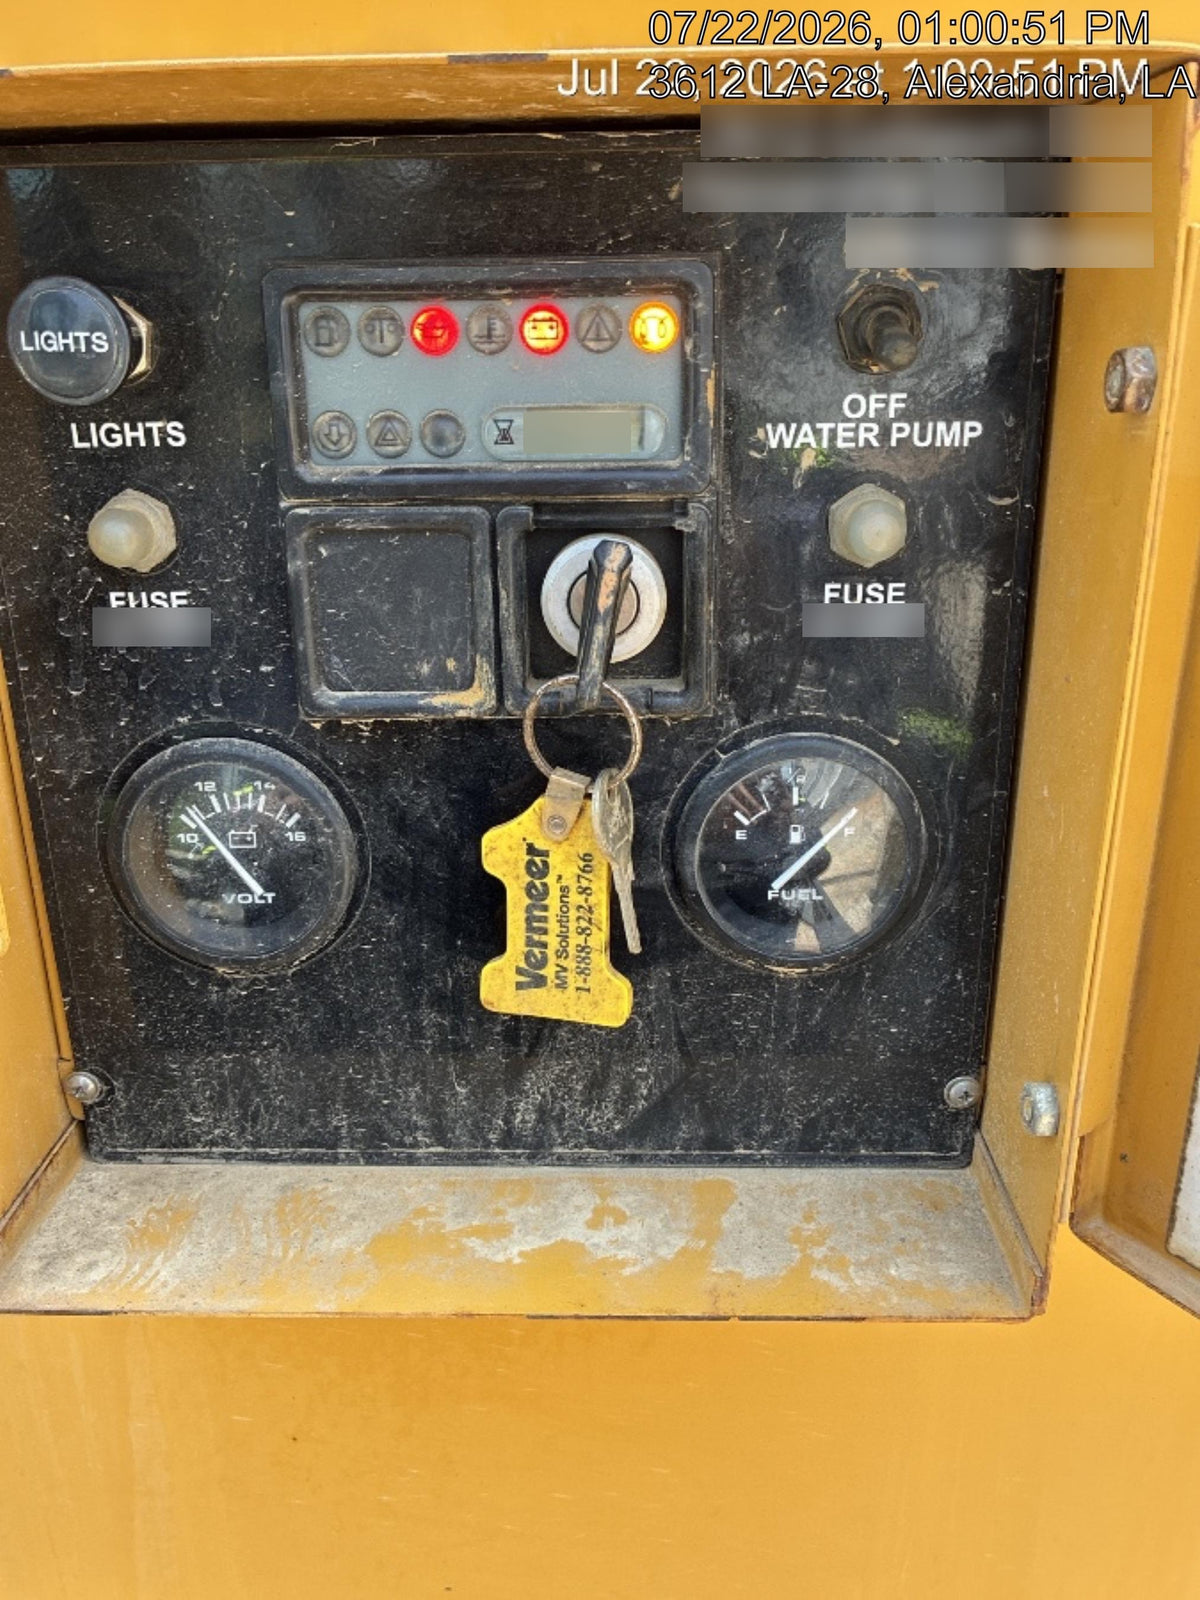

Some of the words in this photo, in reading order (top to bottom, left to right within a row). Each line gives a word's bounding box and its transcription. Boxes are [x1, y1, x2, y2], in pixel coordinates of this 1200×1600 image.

[20, 330, 109, 353] LIGHTS
[842, 393, 907, 419] OFF
[70, 421, 187, 449] LIGHTS
[766, 422, 880, 449] WATER
[890, 420, 983, 448] PUMP
[823, 583, 906, 604] FUSE
[194, 781, 217, 792] 12
[253, 780, 276, 791] 14
[176, 832, 199, 844] 10
[285, 831, 307, 842] 16
[735, 829, 748, 840] E
[844, 827, 857, 837] F
[222, 892, 276, 904] VOLT
[767, 889, 824, 901] FUEL
[515, 840, 550, 992] Vermeer
[575, 852, 595, 994] 1-888-822-8766
[554, 961, 569, 990] MV
